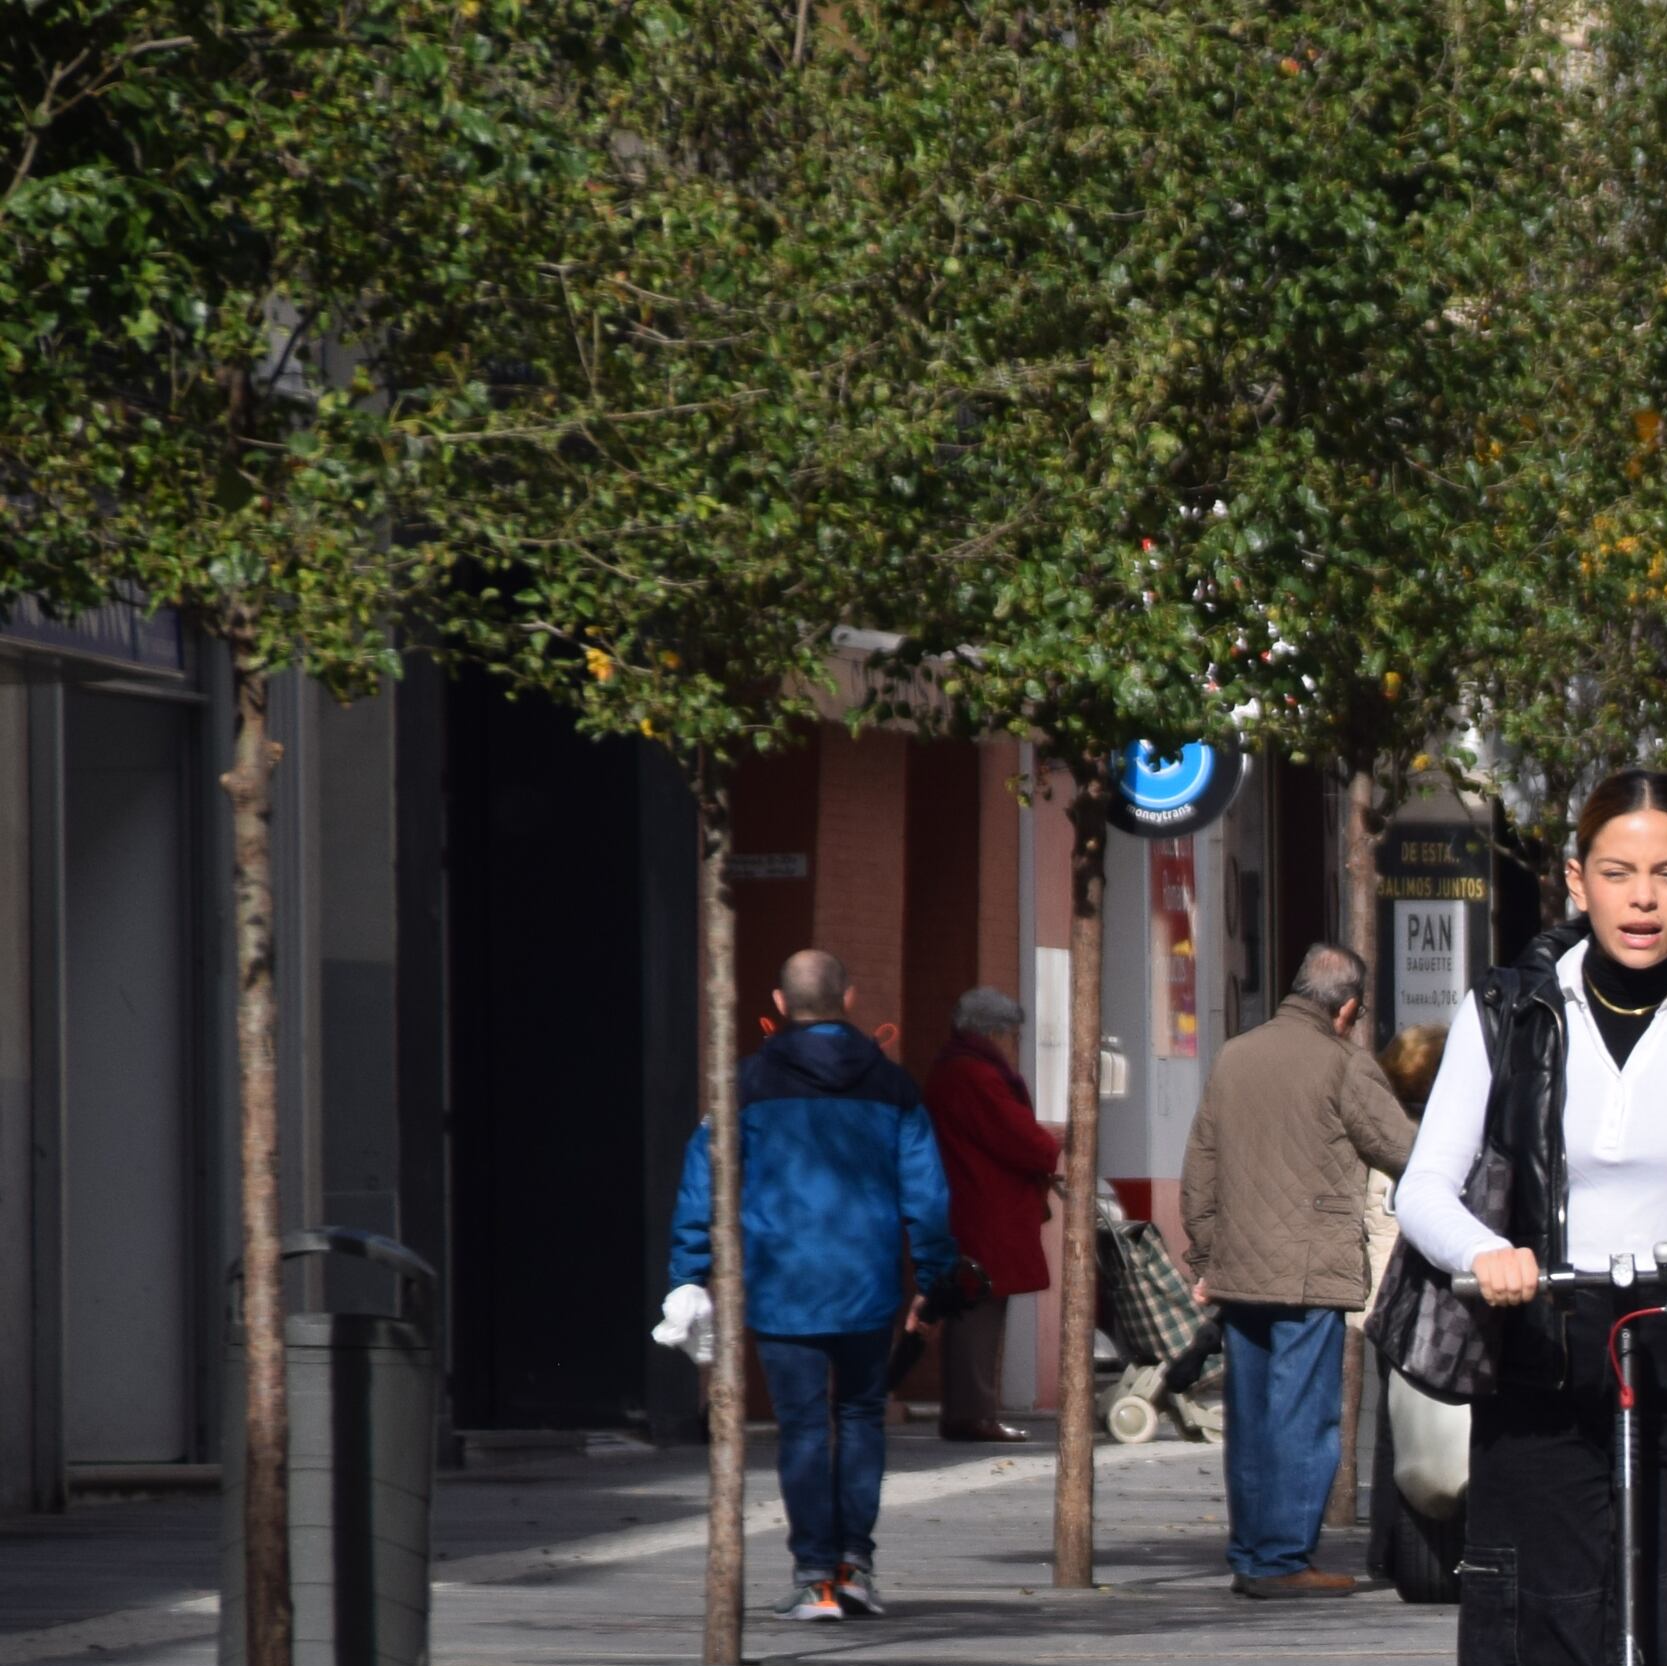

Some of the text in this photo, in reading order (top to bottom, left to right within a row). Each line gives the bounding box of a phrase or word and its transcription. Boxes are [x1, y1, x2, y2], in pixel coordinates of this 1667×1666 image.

[1126, 803, 1193, 823] moneytrans
[1402, 841, 1417, 863] DE
[1377, 875, 1485, 899] SALIMOS JUNTOS
[1407, 913, 1452, 952] PAN
[1406, 956, 1452, 973] BAGUETTE
